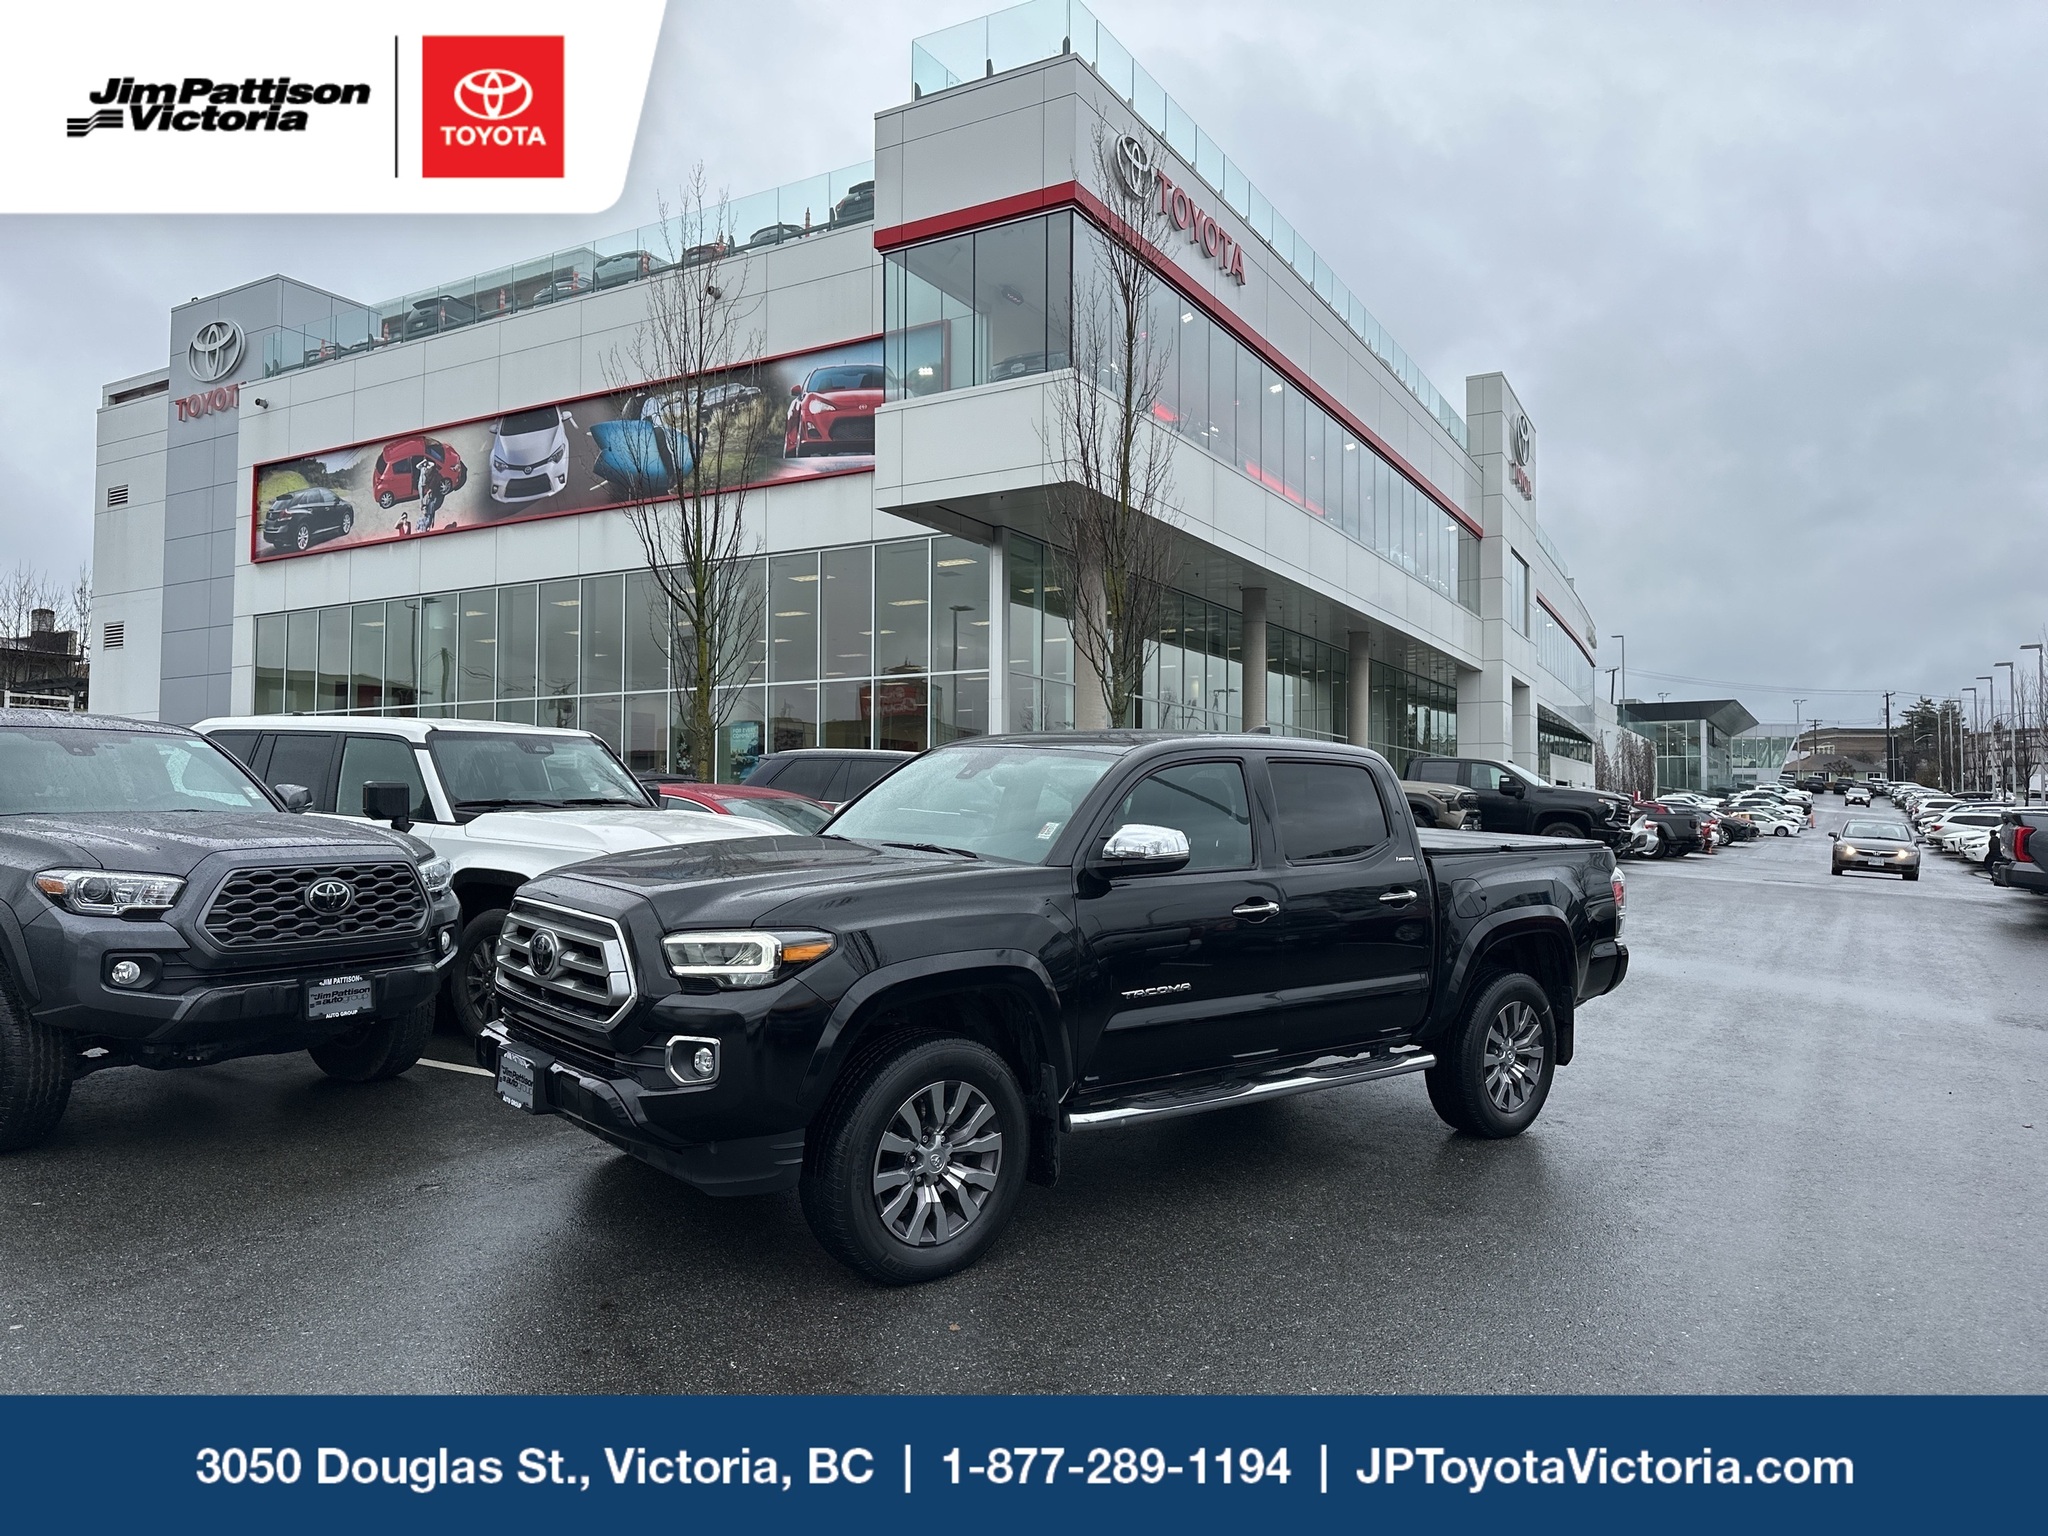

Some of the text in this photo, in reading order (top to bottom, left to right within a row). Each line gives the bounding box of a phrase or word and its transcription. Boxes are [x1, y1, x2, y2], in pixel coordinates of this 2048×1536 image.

[1154, 168, 1246, 285] TOYOTA
[175, 381, 246, 422] TOYOT
[333, 975, 360, 984] PATTISON
[1121, 982, 1192, 999] TACOMA
[339, 1009, 358, 1017] GROUP
